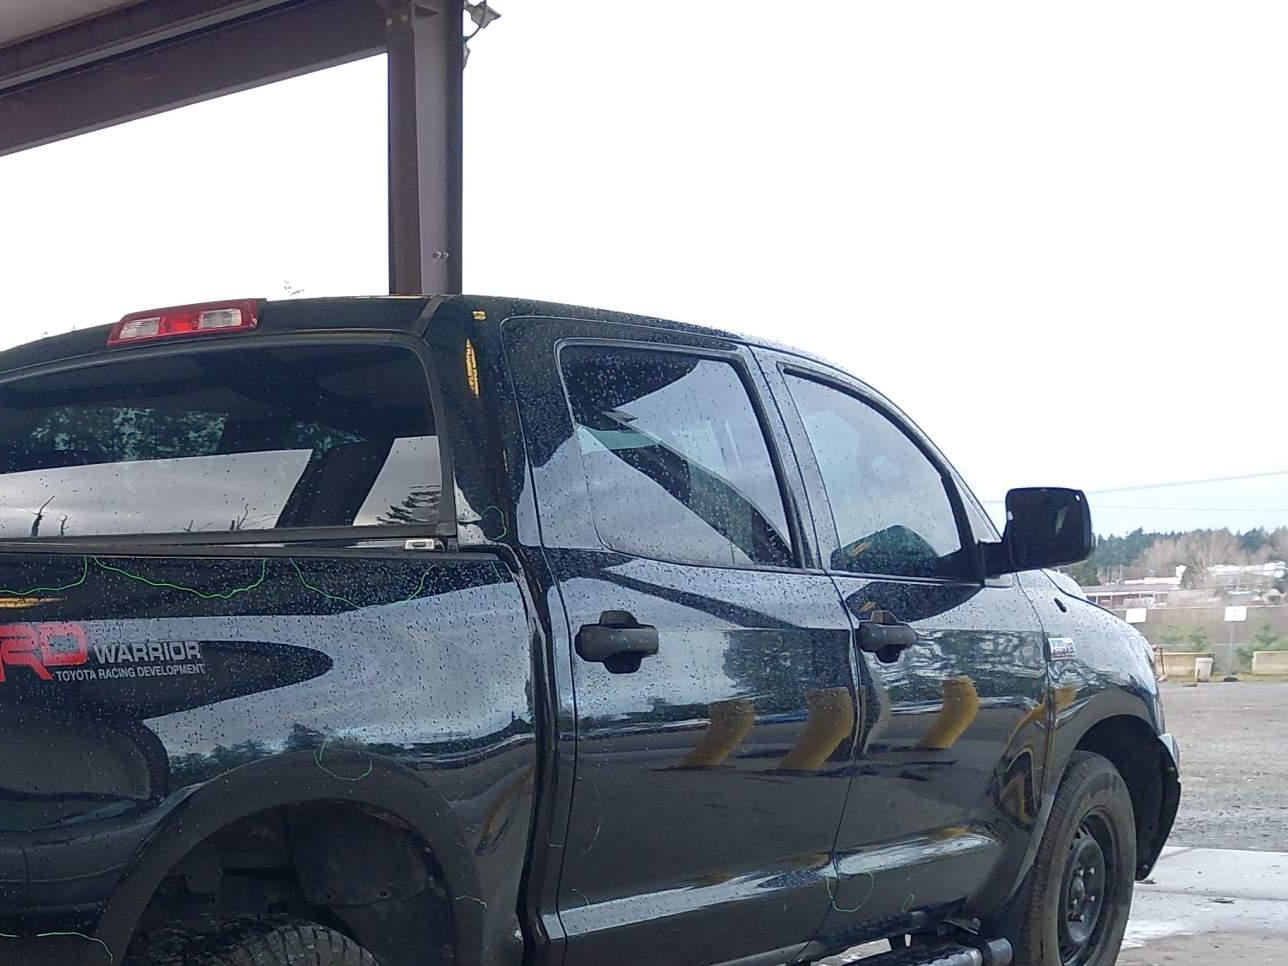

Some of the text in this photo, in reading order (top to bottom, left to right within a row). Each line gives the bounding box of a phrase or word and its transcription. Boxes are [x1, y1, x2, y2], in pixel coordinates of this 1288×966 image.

[93, 641, 201, 664] WARRIOR
[56, 663, 206, 682] TOYOTA RACING DEVELOPMENT
